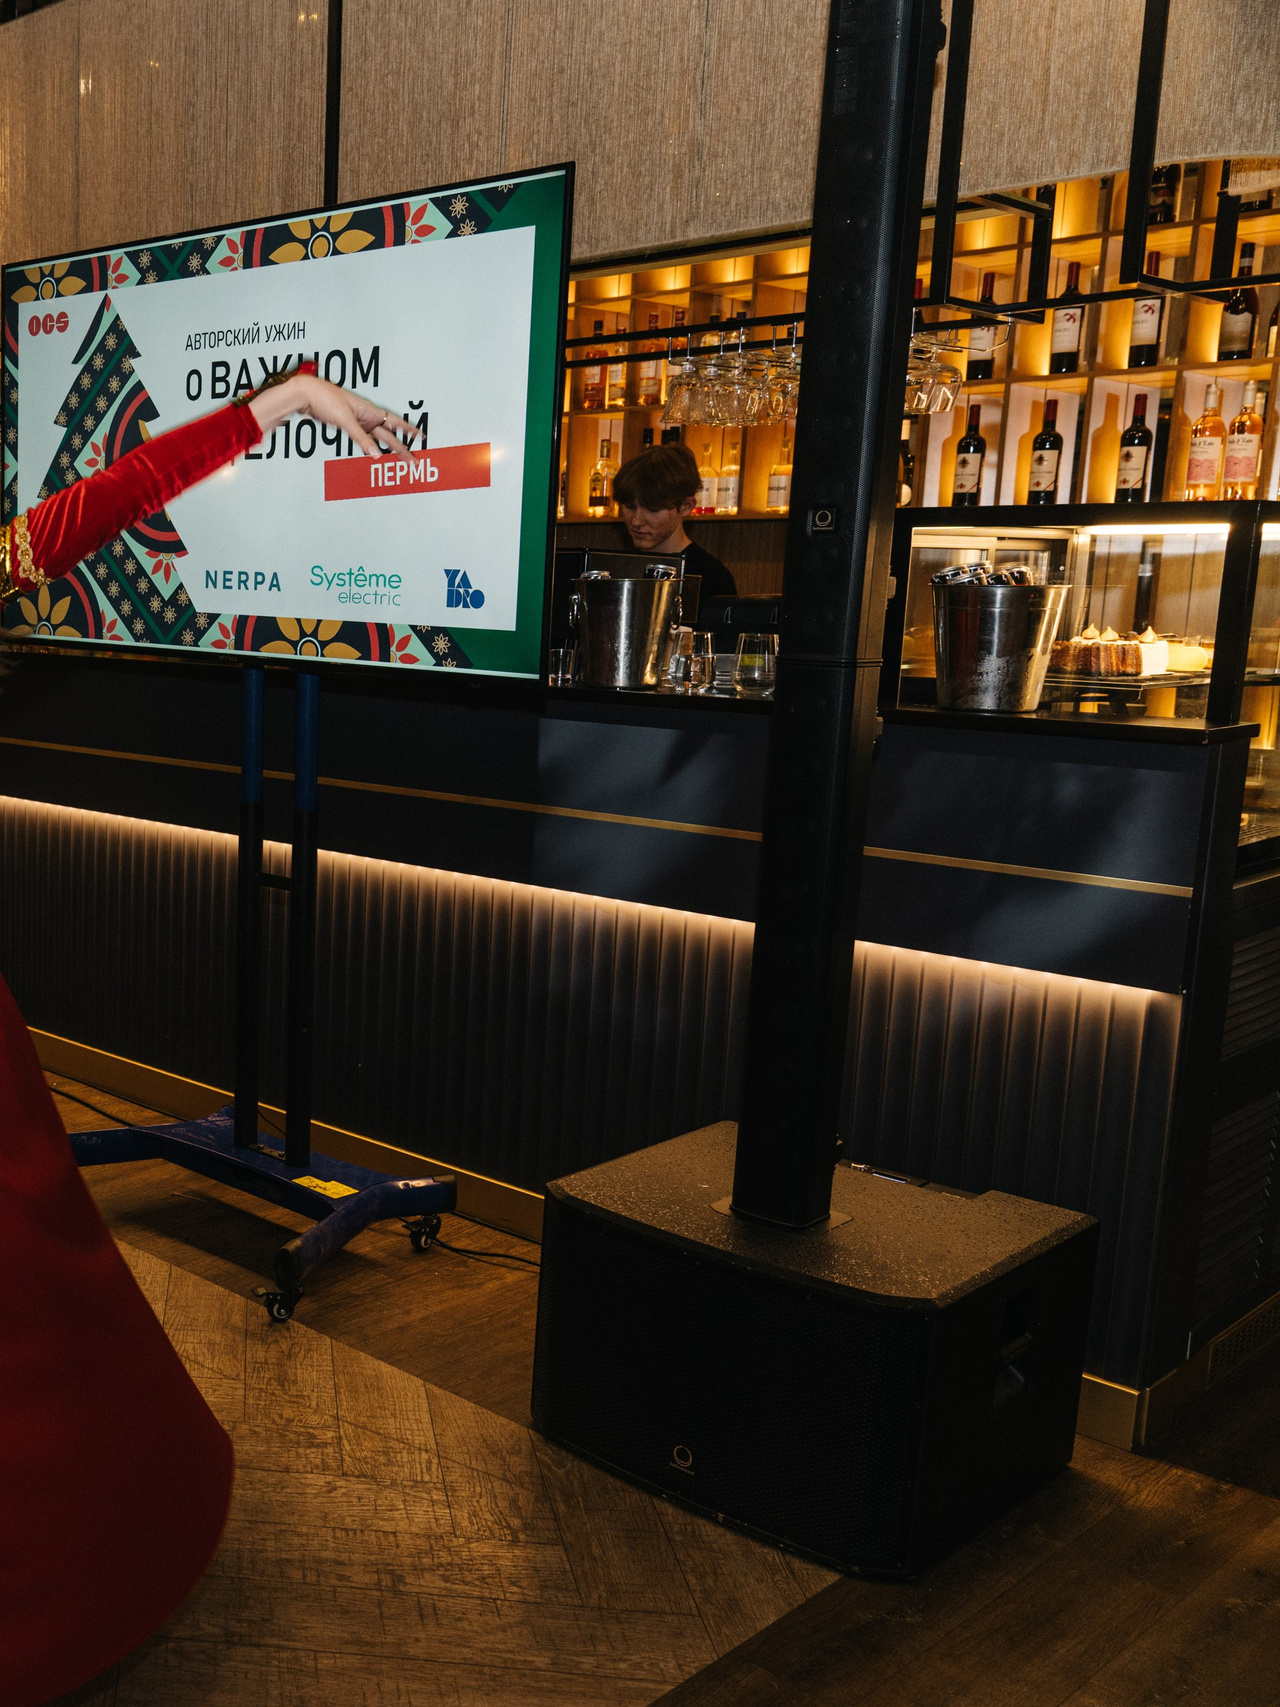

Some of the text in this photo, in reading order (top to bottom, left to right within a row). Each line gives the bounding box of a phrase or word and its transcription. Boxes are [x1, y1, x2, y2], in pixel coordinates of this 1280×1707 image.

[28, 311, 70, 337] OCS
[185, 320, 307, 352] АВТОРСКИЙ УЖИН
[370, 457, 440, 488] ПЕРМЬ
[205, 569, 282, 592] NERPA
[310, 564, 403, 591] Systême
[337, 588, 402, 607] electric
